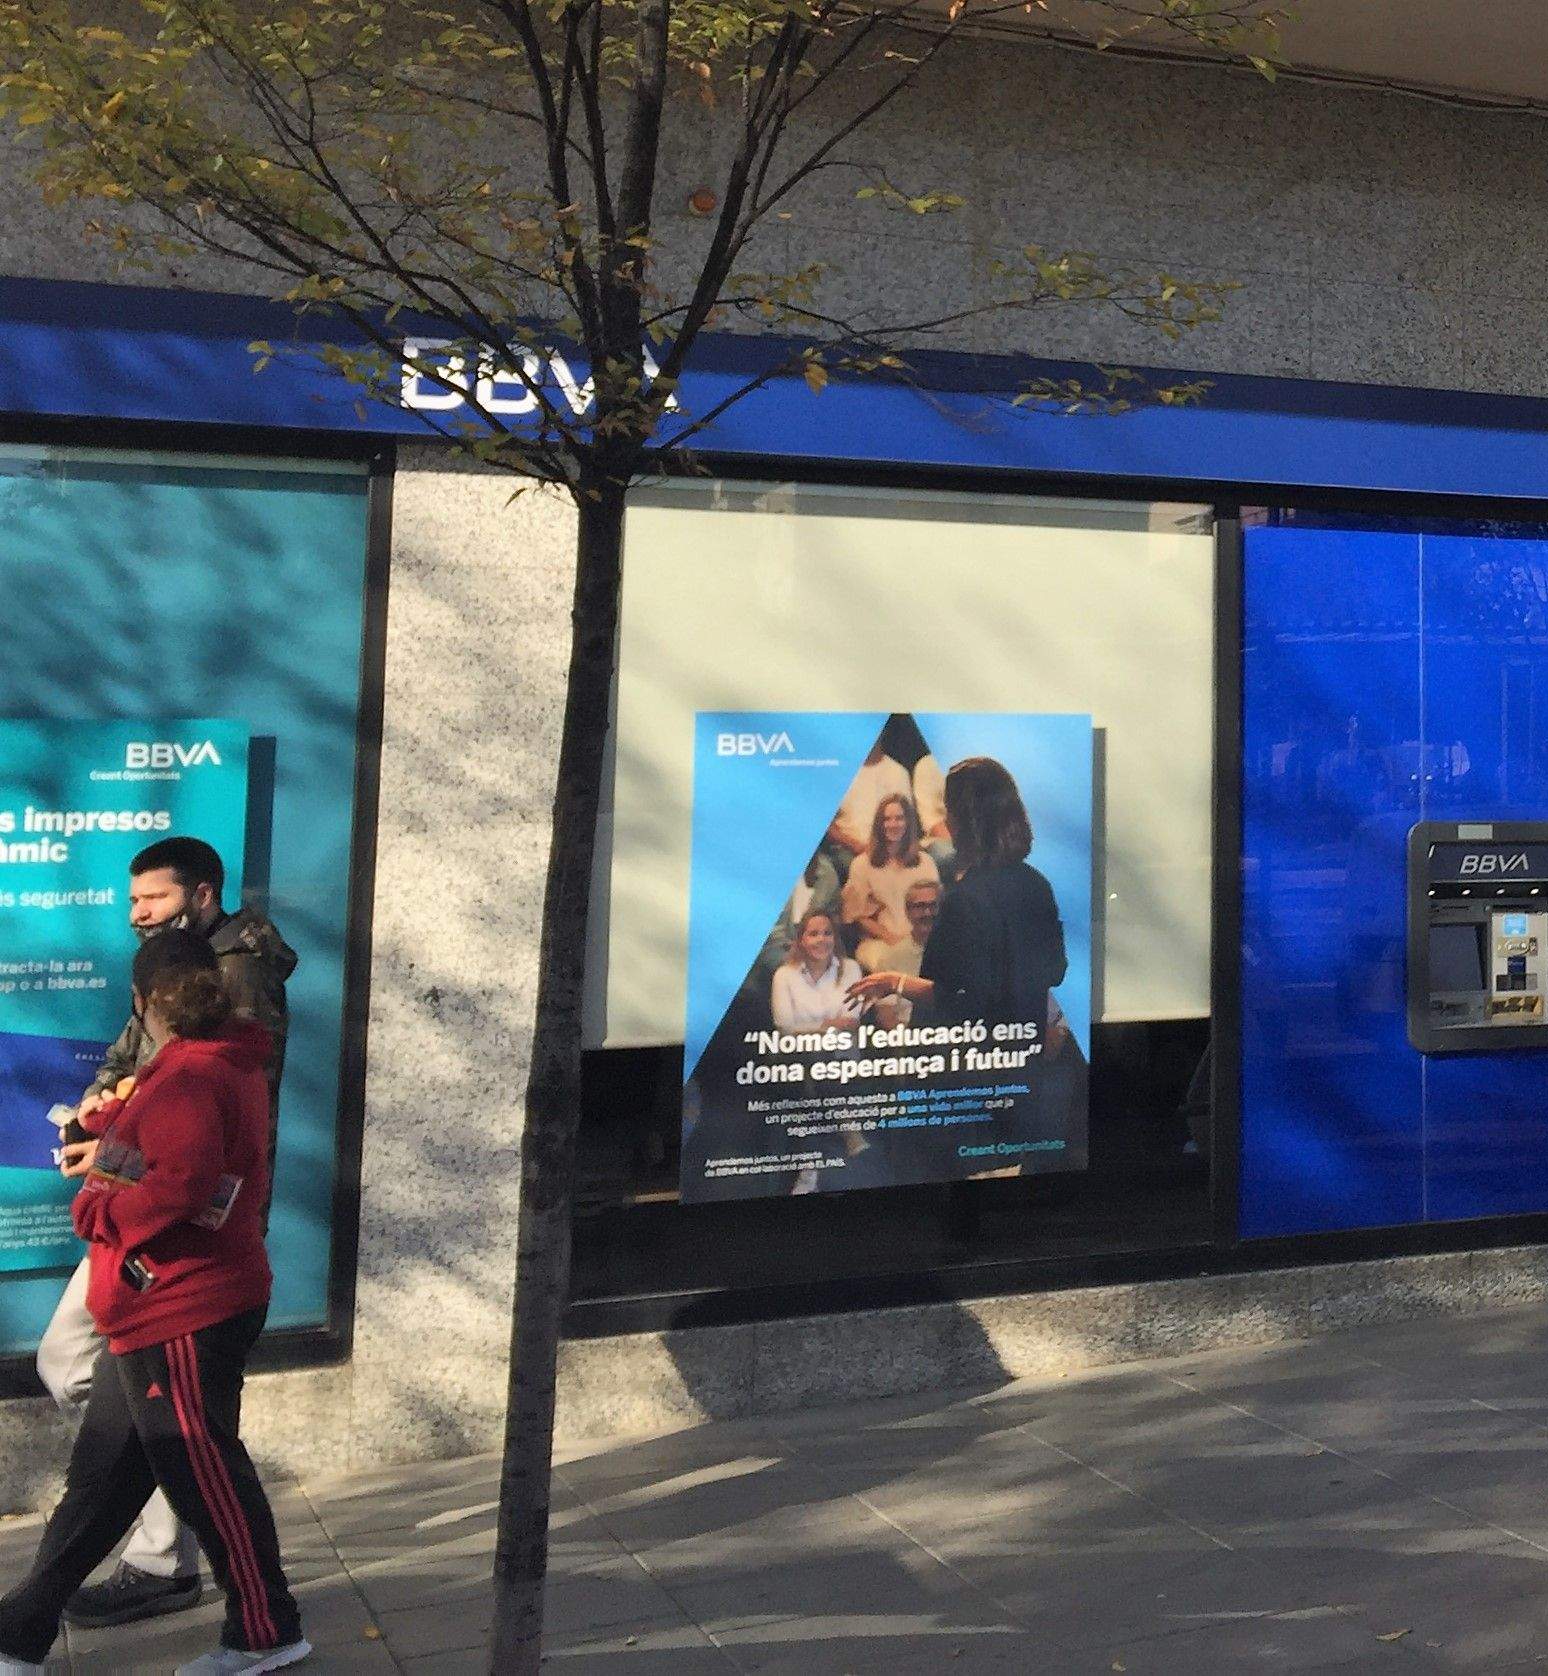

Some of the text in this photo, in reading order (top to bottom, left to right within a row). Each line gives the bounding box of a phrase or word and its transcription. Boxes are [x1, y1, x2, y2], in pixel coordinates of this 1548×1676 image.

[126, 740, 222, 769] BBVA
[717, 731, 796, 757] BBVA
[24, 805, 171, 837] impresos
[1459, 851, 1530, 875] BBVA
[20, 887, 115, 910] seguretat
[48, 977, 107, 990] bbva.es
[744, 1018, 1039, 1055] “Només l’educació ens
[736, 1043, 1043, 1086] dona esperança i futur”
[747, 1100, 770, 1112] Més
[823, 1096, 846, 1107] com
[847, 1092, 888, 1106] aquesta
[889, 1092, 897, 1102] a
[765, 1114, 780, 1125] un
[781, 1110, 823, 1125] projecte
[880, 1105, 898, 1118] per
[898, 1105, 907, 1115] a
[840, 1120, 862, 1132] més
[863, 1119, 877, 1131] de
[958, 1144, 996, 1158] Creant
